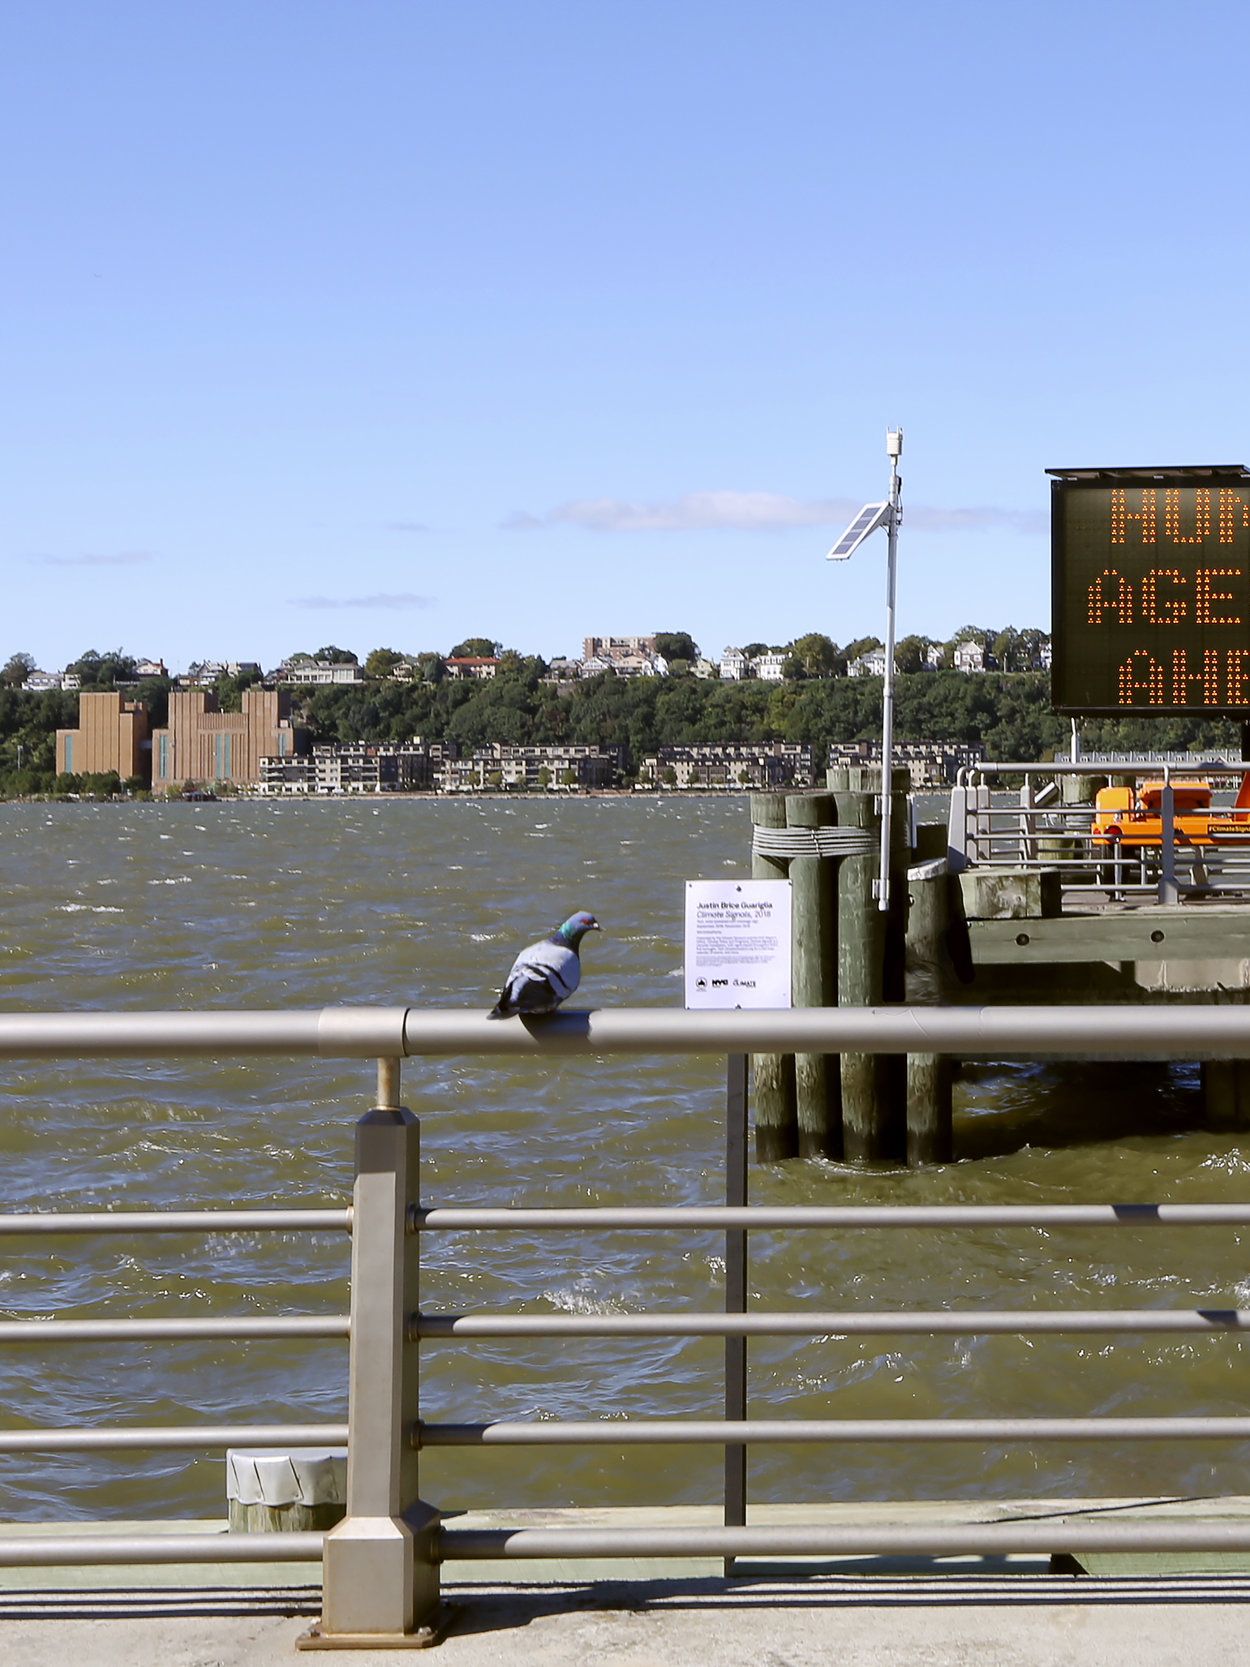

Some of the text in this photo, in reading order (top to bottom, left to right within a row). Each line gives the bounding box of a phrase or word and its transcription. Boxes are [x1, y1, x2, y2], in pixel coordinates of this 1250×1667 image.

[697, 902, 773, 911] Justin Brice Guariglia
